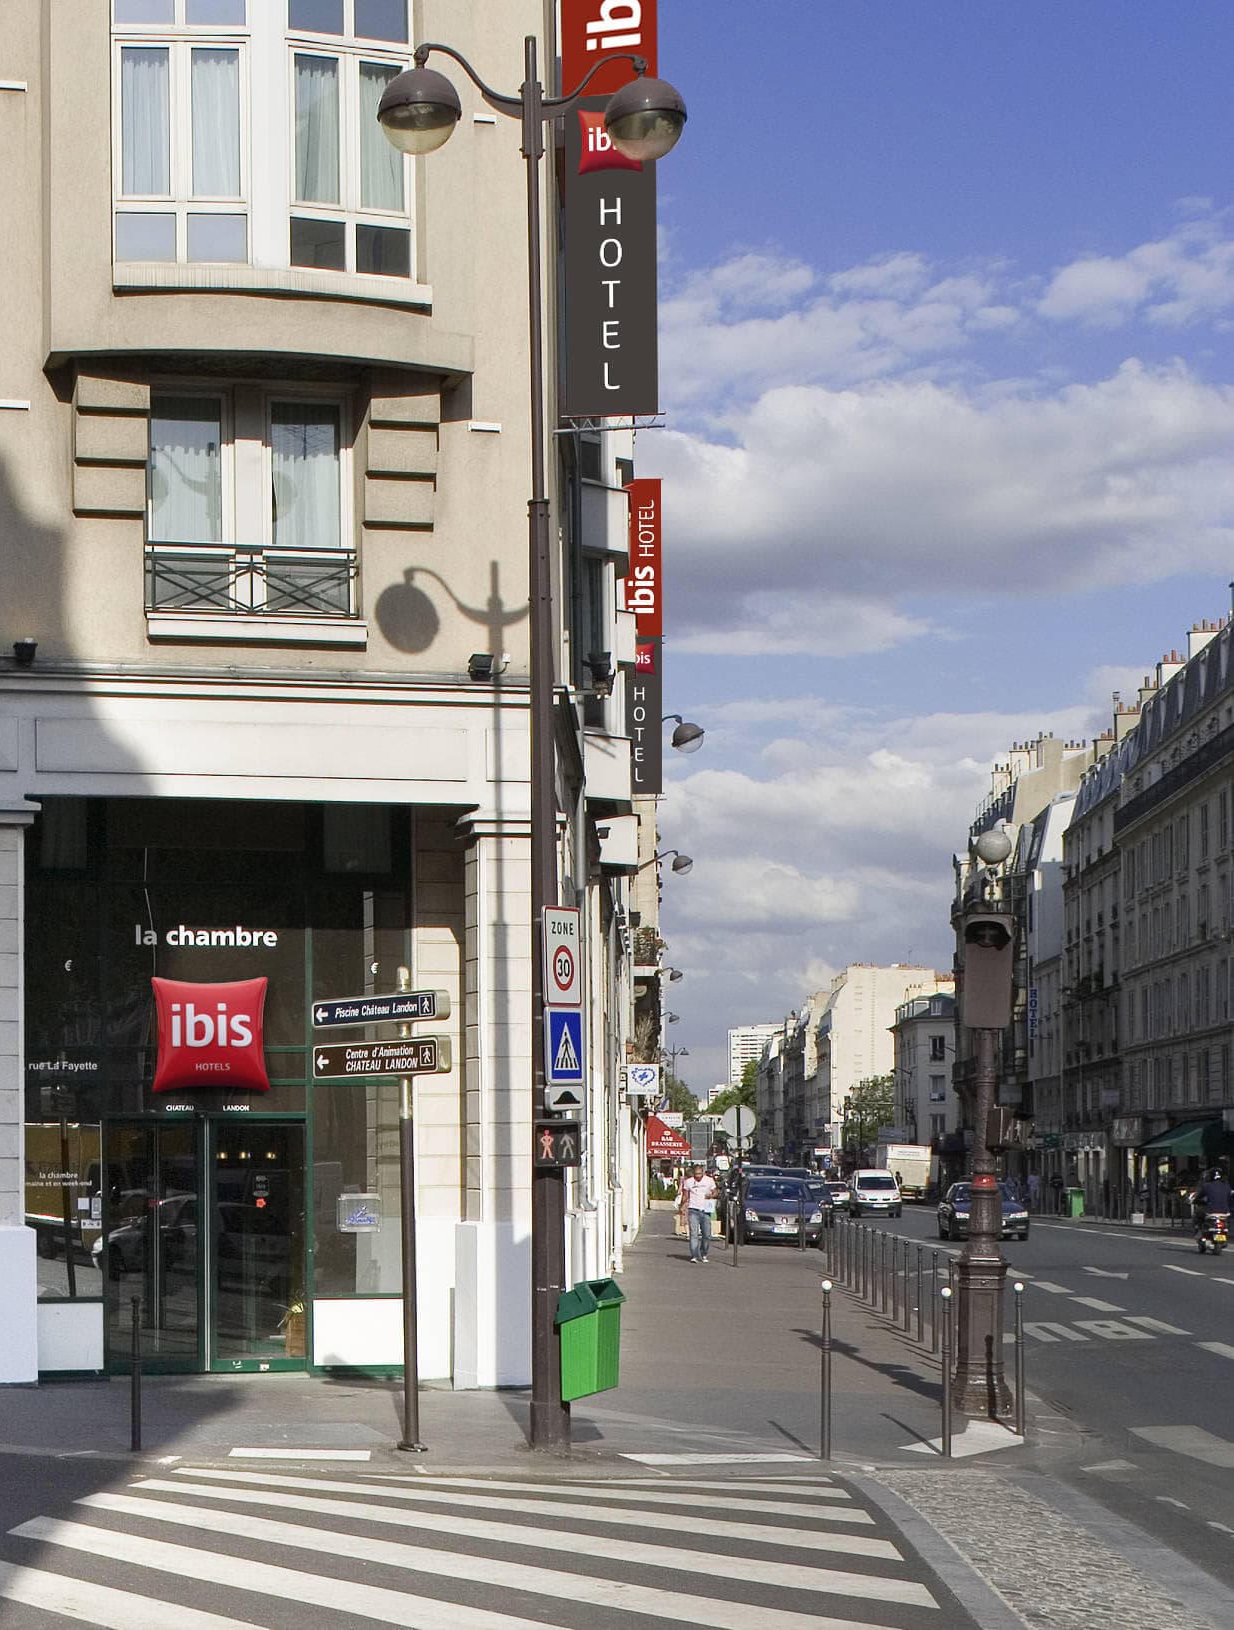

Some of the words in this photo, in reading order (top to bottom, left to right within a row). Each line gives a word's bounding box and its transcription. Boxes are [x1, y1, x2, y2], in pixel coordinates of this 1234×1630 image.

[588, 127, 618, 152] ib
[599, 197, 623, 390] HOTEL
[638, 499, 655, 557] HOTEL
[627, 565, 655, 614] ibis
[633, 686, 646, 782] HOTEL
[135, 924, 158, 945] la
[166, 925, 279, 947] chambre
[551, 921, 574, 936] ZONE
[557, 959, 570, 978] 30
[334, 1006, 359, 1019] Piscine
[392, 1002, 417, 1014] Landon
[1029, 988, 1038, 1038] HOTEL
[171, 1003, 253, 1048] ibis
[345, 1048, 368, 1059] Centre
[372, 1045, 414, 1057] d'Animation
[28, 1063, 44, 1071] rue
[47, 1061, 59, 1071] La
[62, 1061, 98, 1073] Fayette
[195, 1062, 231, 1071] HOTELS
[345, 1060, 381, 1072] CHATEAU
[385, 1058, 418, 1070] LANDON
[222, 1104, 250, 1112] LANDON
